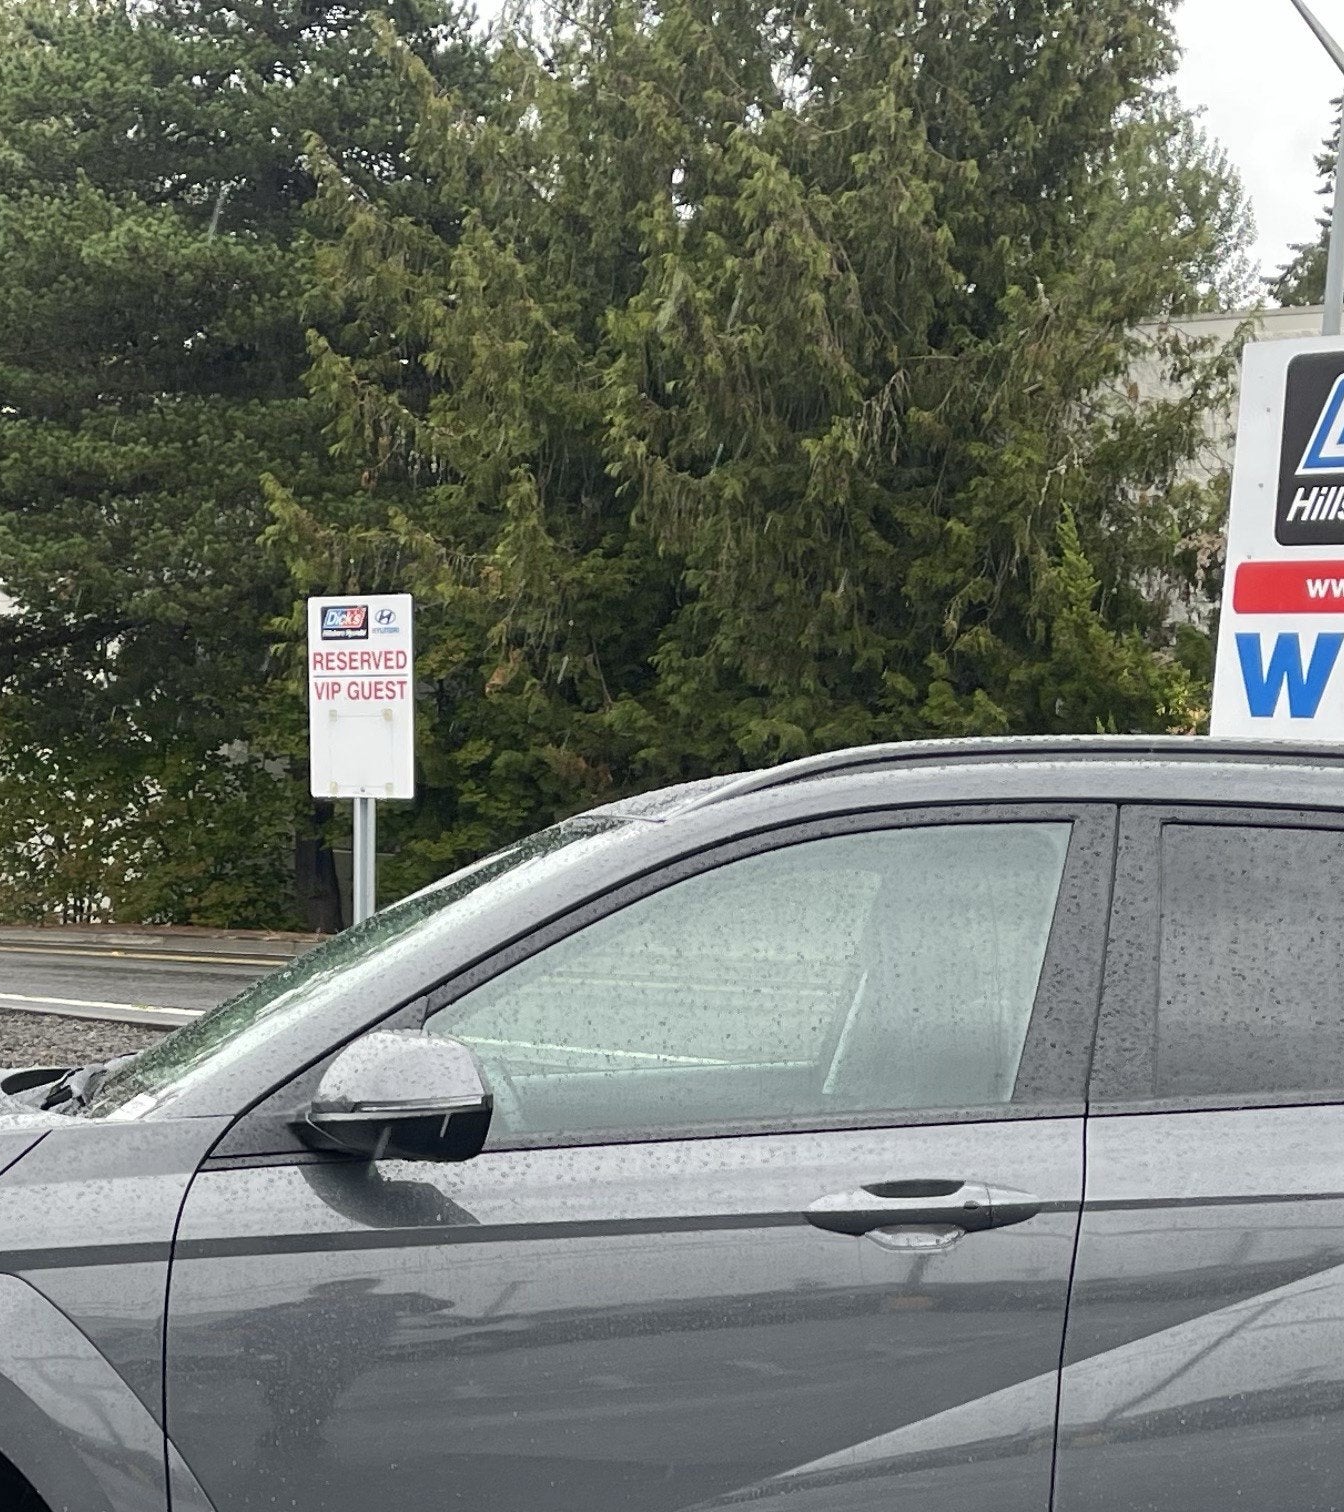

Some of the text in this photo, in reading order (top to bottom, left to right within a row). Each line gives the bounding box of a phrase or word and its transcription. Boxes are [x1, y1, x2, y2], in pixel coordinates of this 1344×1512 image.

[313, 650, 407, 671] RESERVED
[314, 680, 407, 700] VIP GUEST
